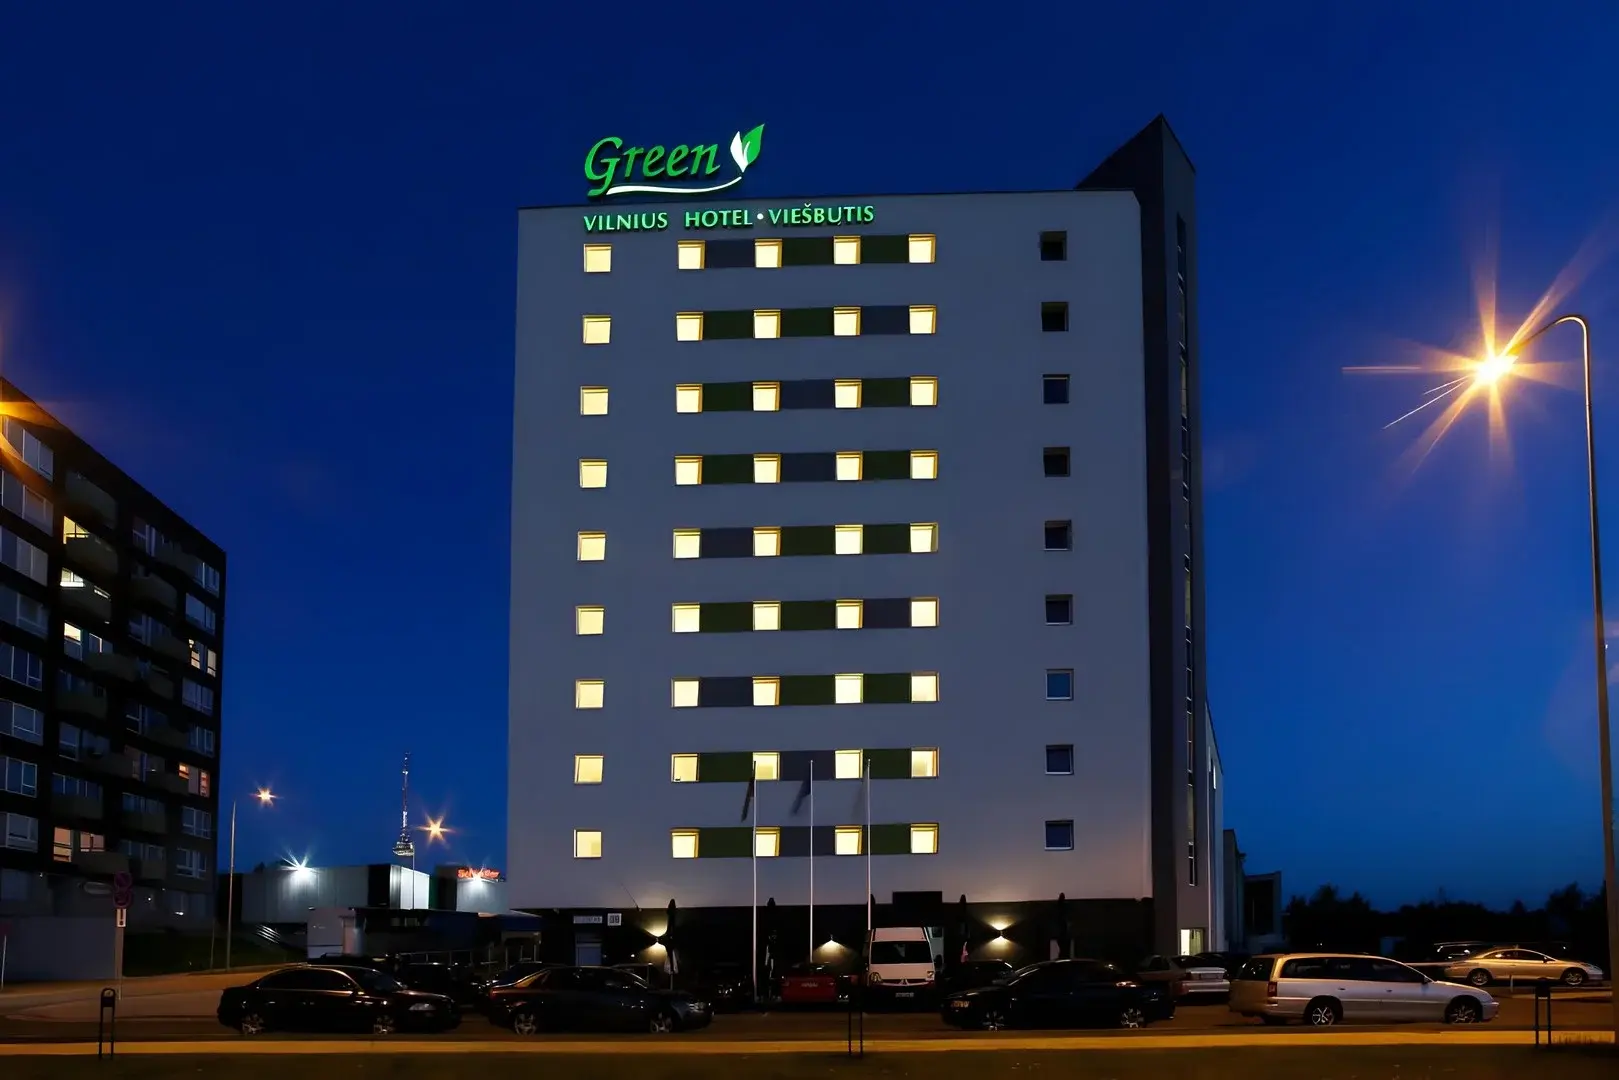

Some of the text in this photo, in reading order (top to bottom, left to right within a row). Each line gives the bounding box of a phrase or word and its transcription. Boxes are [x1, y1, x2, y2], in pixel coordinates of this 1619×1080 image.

[584, 136, 721, 196] Green
[583, 212, 668, 231] VILNIUS
[684, 209, 753, 228] HOTEL
